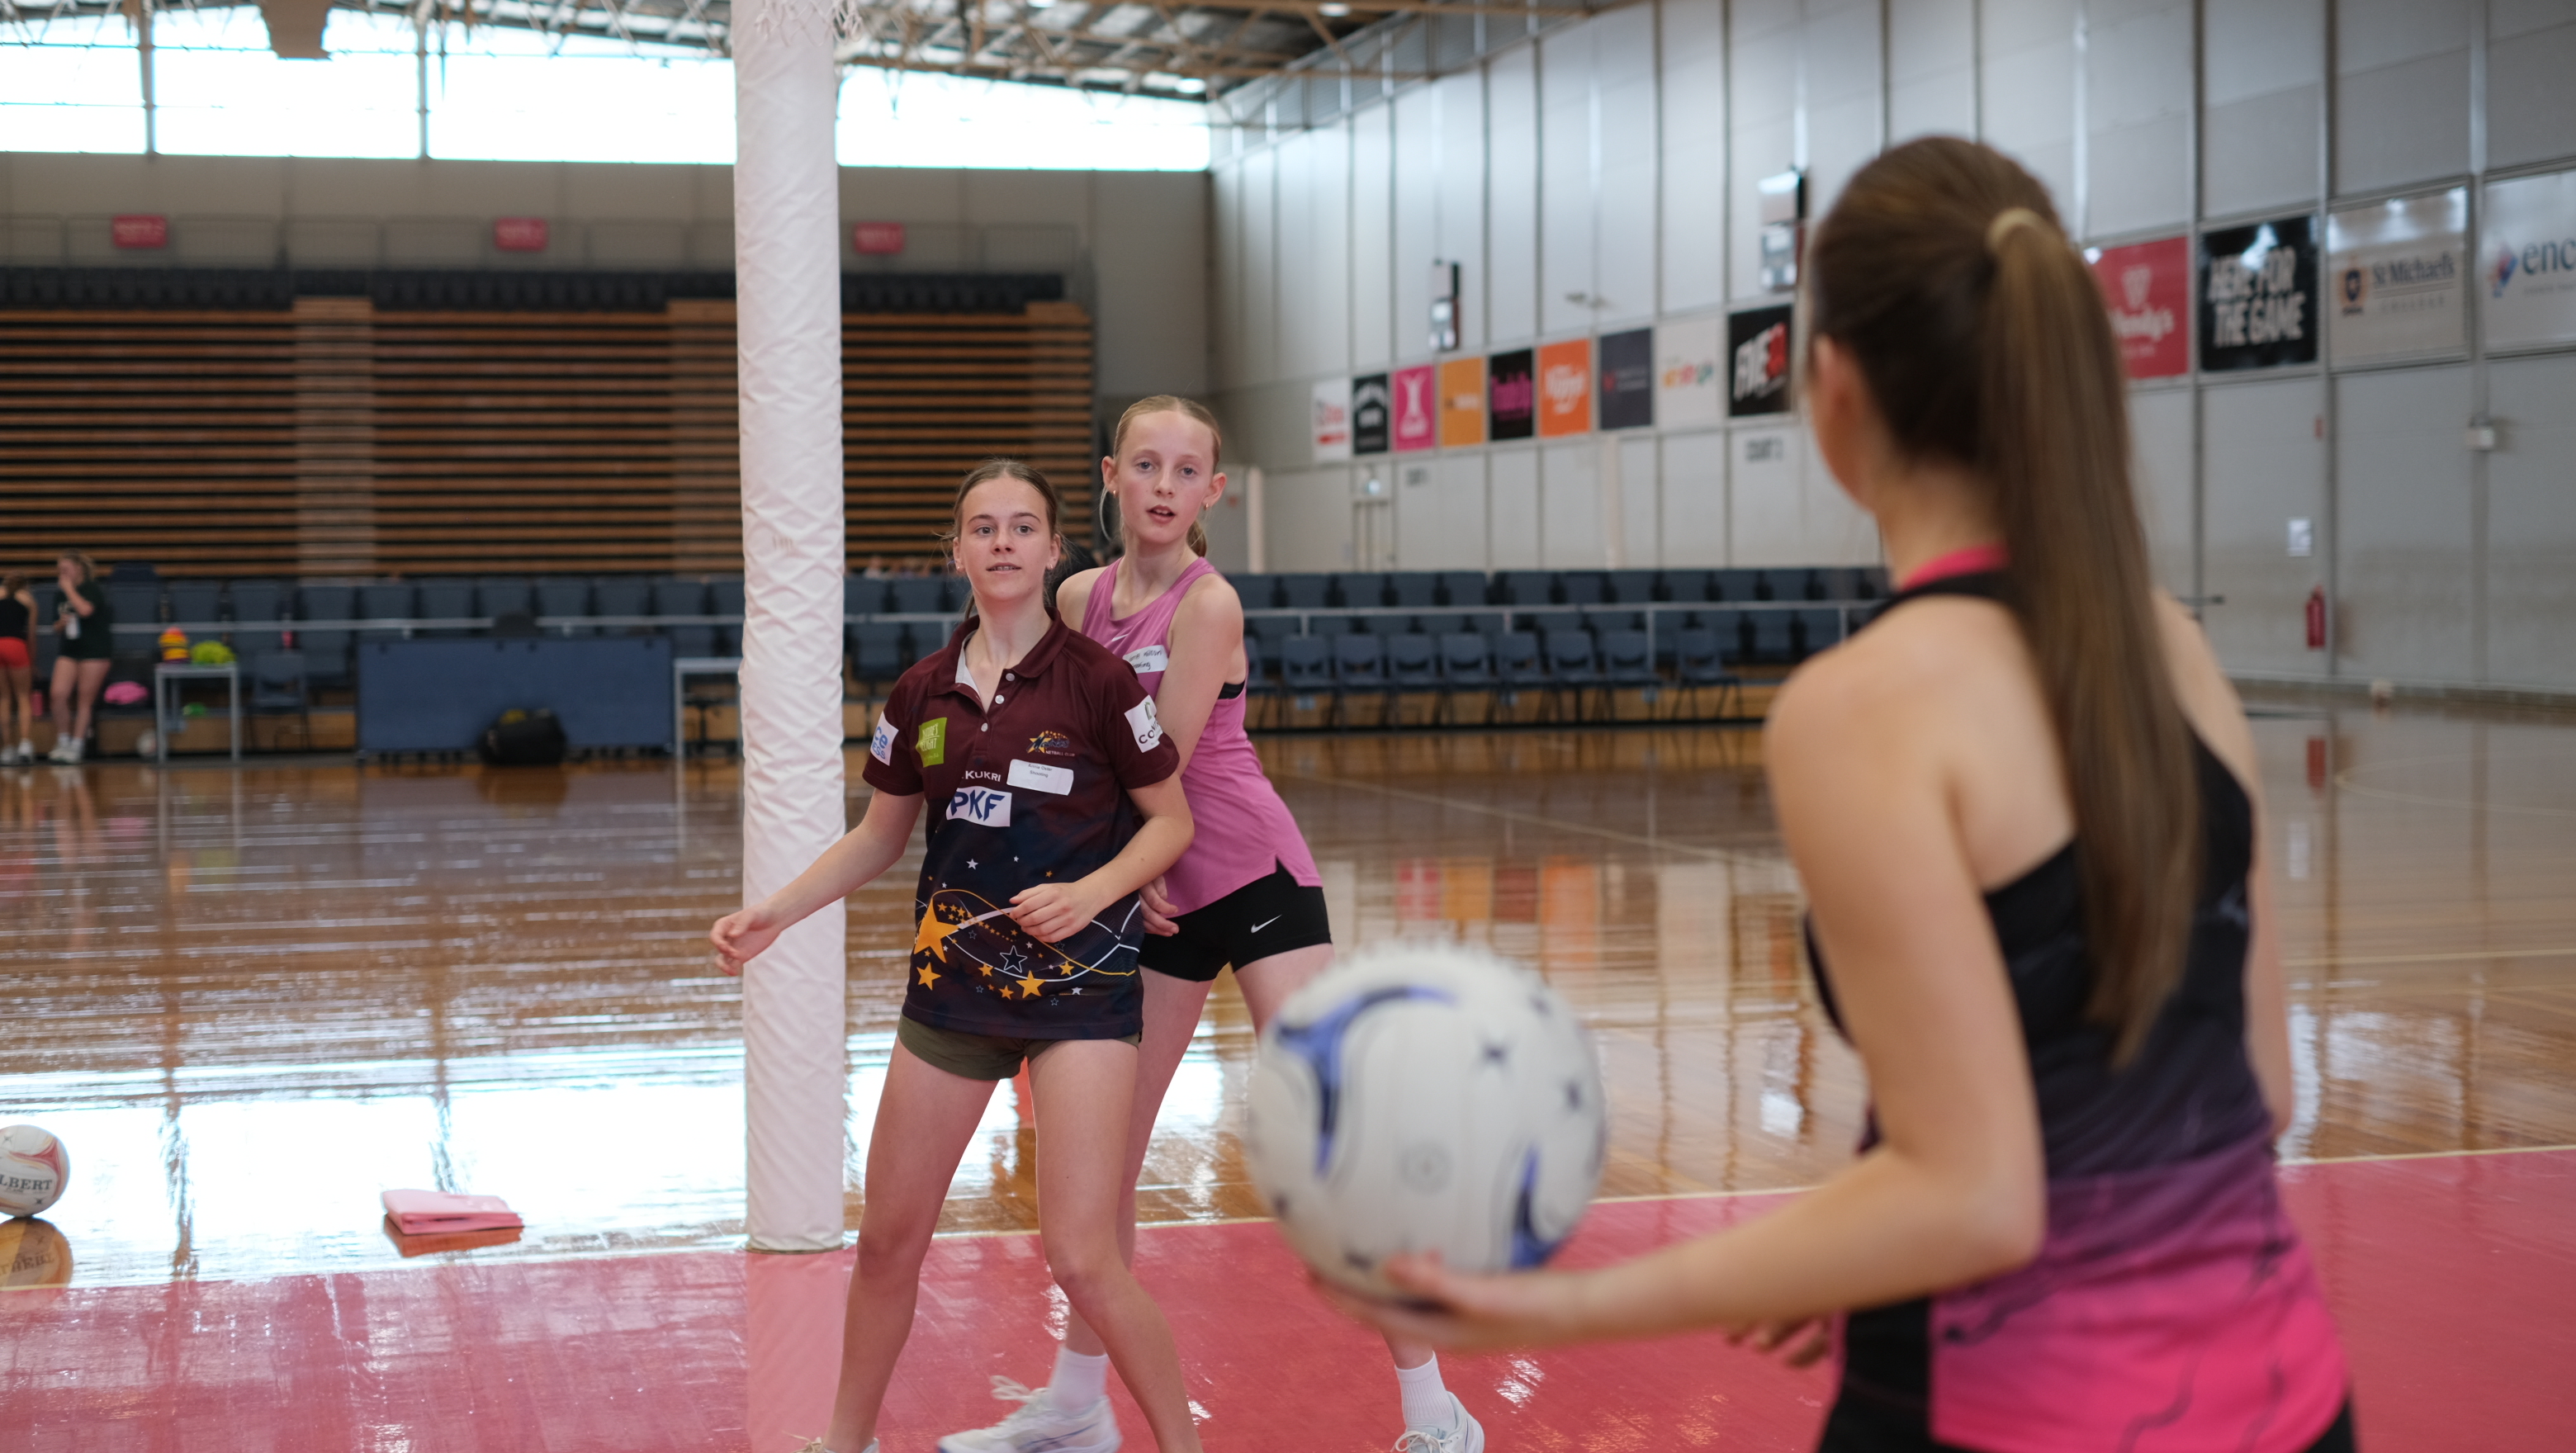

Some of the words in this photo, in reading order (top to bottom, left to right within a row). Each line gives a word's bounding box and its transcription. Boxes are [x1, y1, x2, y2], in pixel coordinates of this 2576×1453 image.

[2214, 301, 2247, 348] THE
[2249, 291, 2306, 345] GAME
[965, 770, 1002, 783] KUKRI
[950, 789, 1006, 821] PKF
